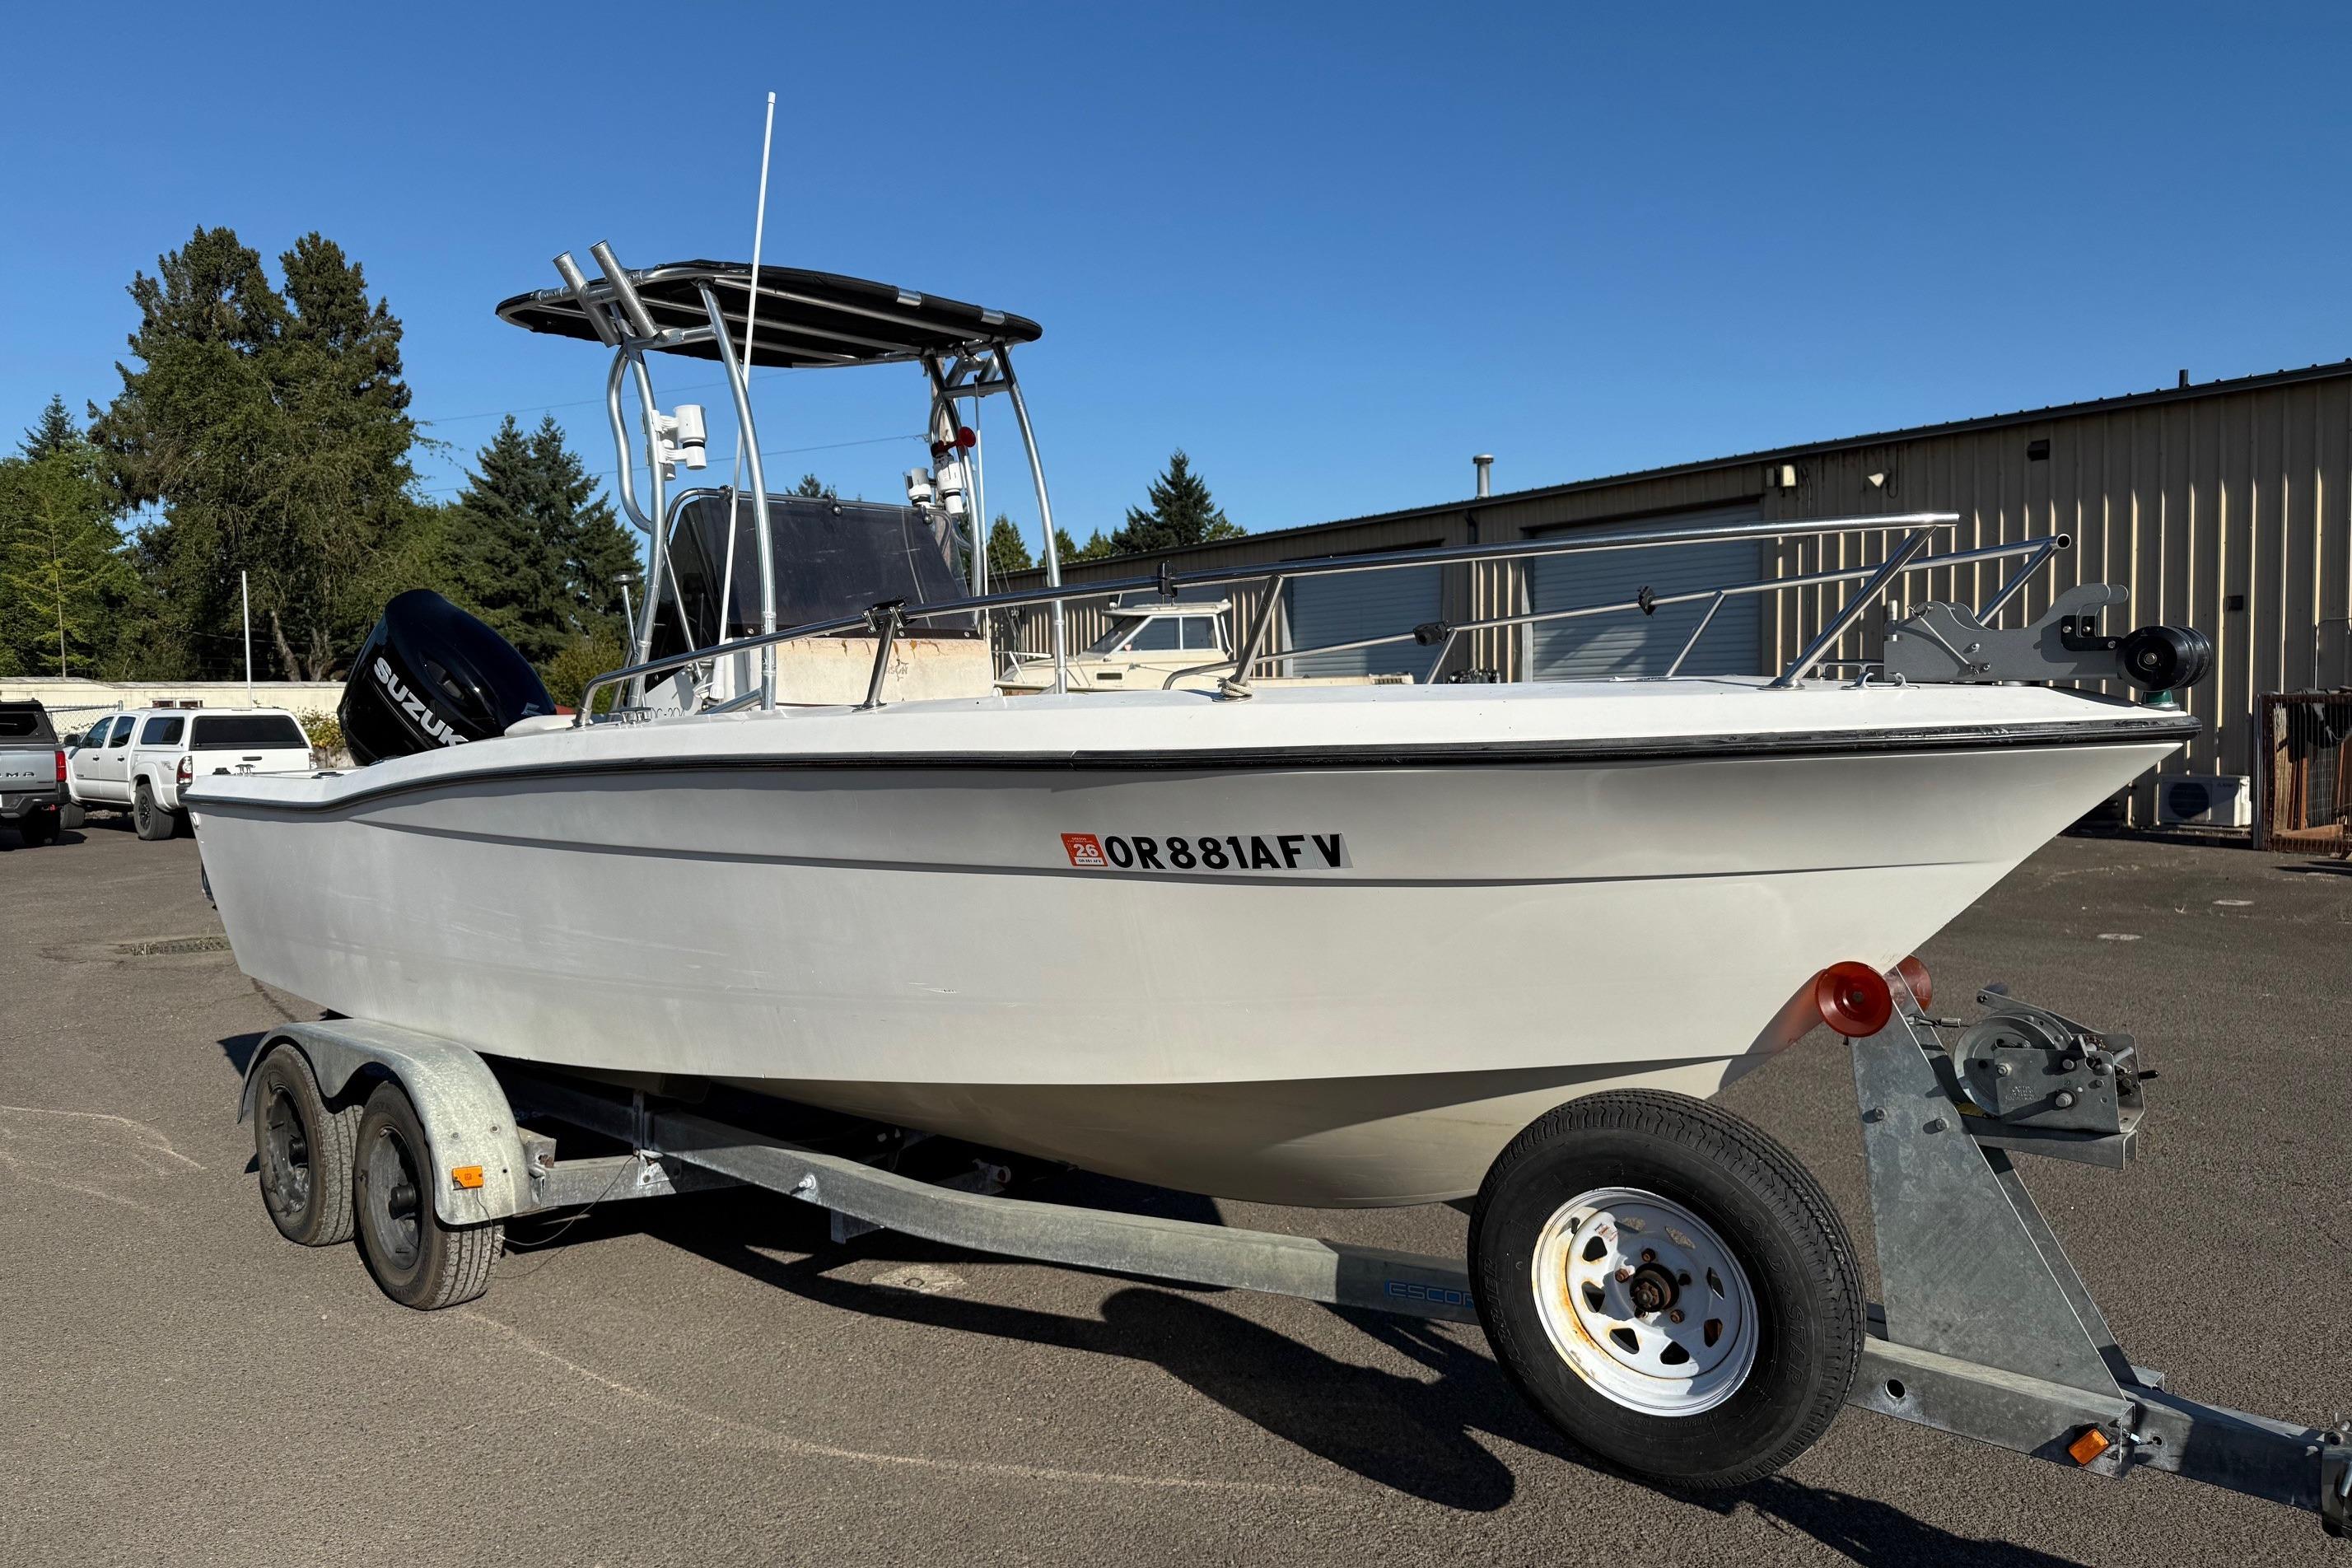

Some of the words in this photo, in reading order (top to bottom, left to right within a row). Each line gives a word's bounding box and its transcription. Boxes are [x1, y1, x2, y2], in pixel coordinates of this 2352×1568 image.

[373, 656, 469, 747] SUZUK
[1073, 843, 1099, 857] 26
[1388, 1282, 1473, 1305] ESCOR
[1784, 1304, 1806, 1384] STAR
